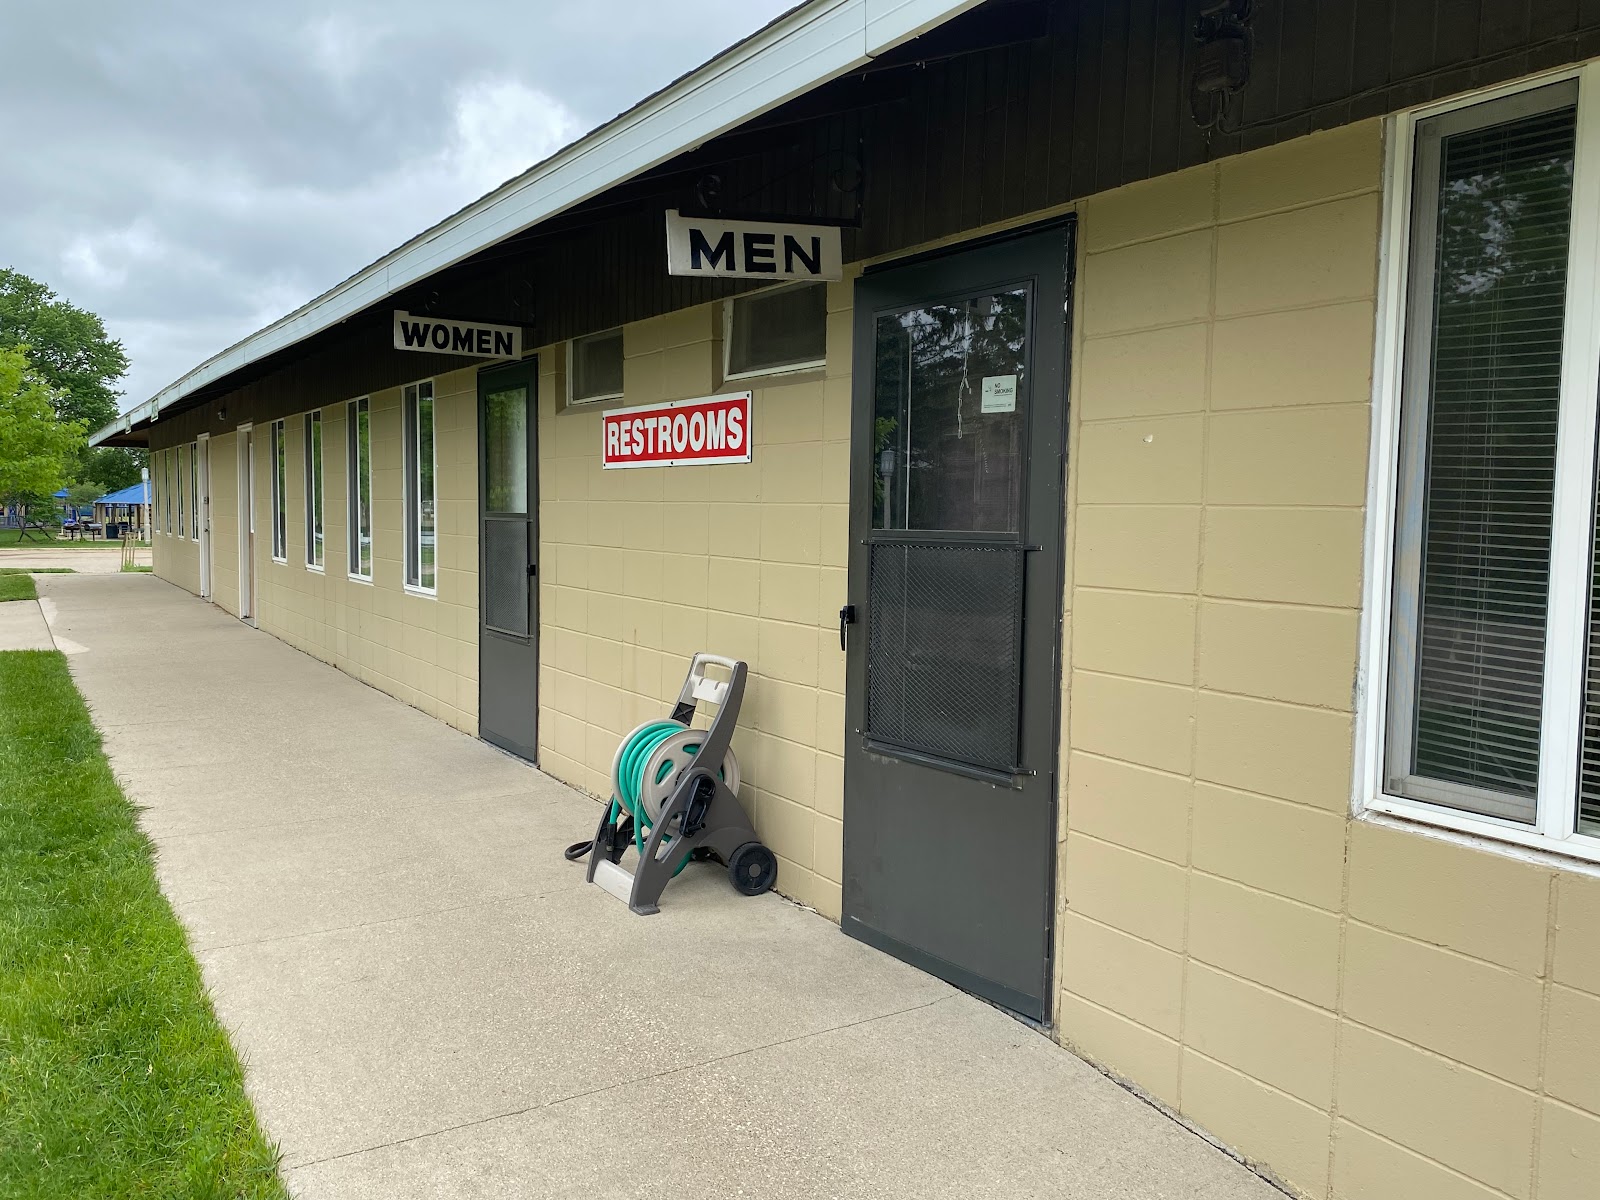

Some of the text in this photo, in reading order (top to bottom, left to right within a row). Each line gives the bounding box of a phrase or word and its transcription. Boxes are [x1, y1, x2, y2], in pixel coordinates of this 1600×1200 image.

[688, 227, 822, 275] MEN
[399, 320, 514, 356] WOMEN
[606, 407, 743, 457] RESTROOMS
